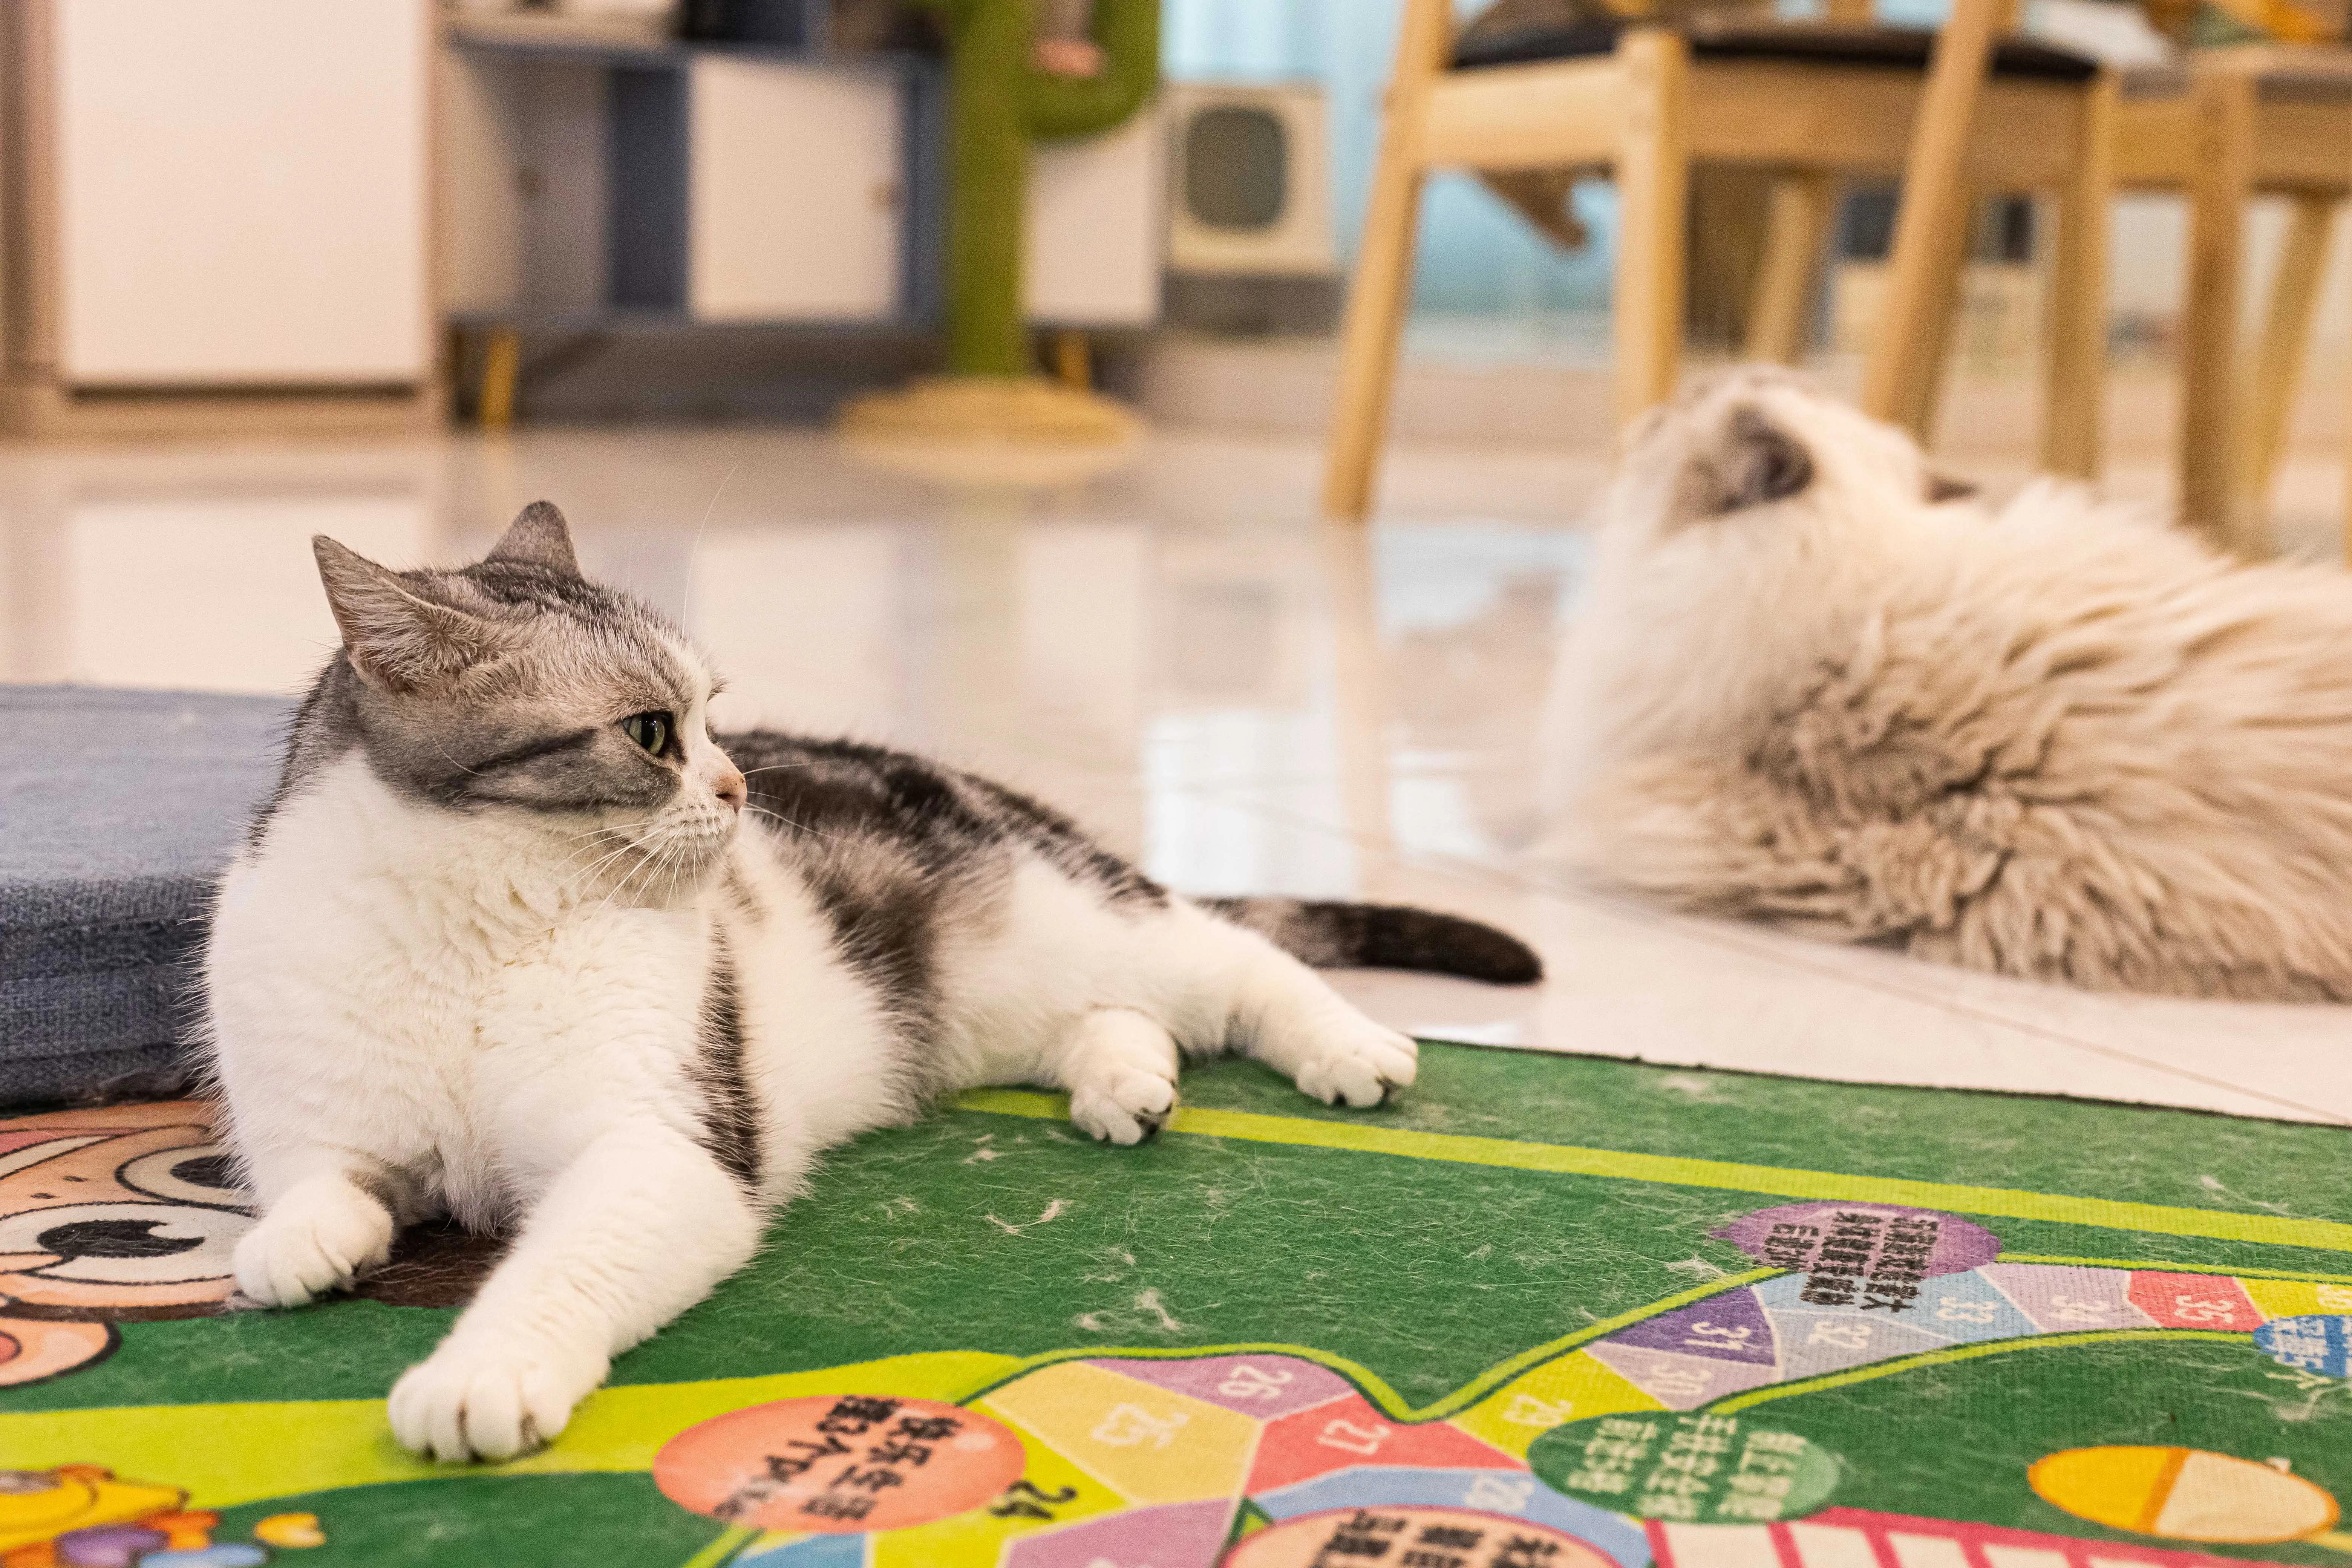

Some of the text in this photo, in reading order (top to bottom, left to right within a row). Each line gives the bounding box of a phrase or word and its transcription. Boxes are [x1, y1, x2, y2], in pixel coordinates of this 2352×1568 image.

[1936, 1296, 1999, 1324] 33
[2174, 1295, 2234, 1325] 35
[1685, 1322, 1752, 1351] 31
[1806, 1322, 1873, 1349] 32
[1217, 1364, 1293, 1399] 26
[1317, 1419, 1392, 1455] 27
